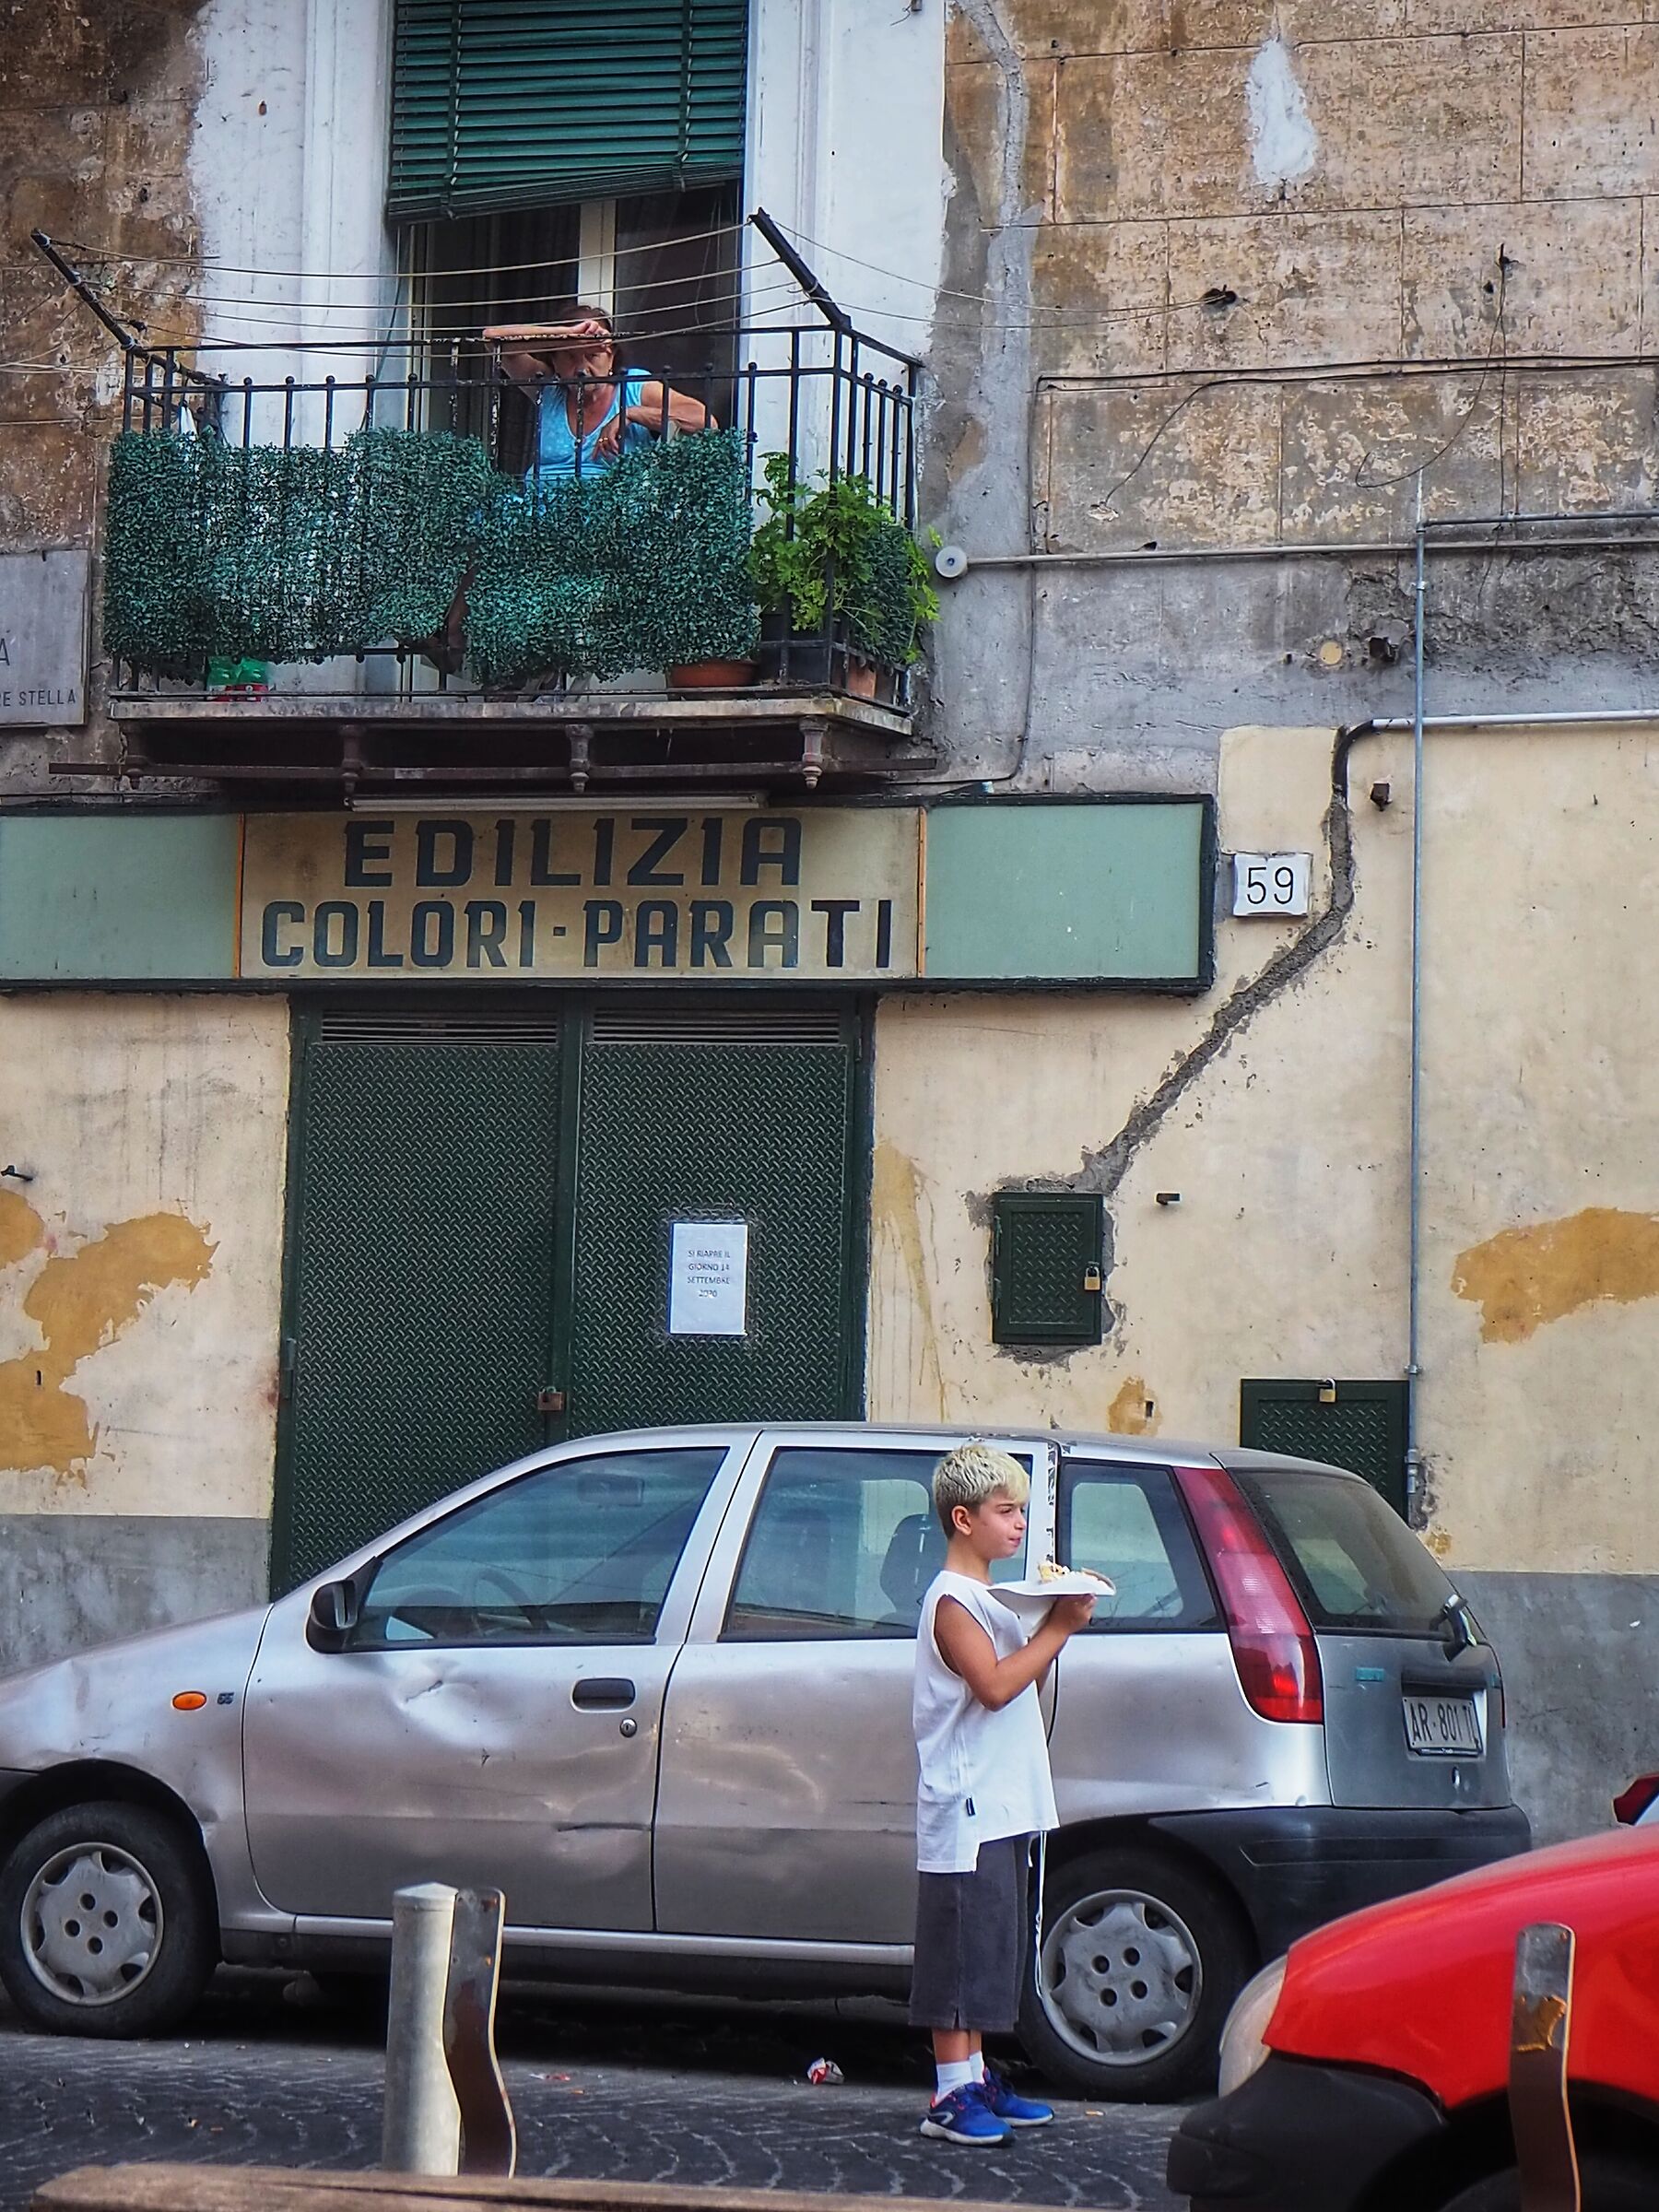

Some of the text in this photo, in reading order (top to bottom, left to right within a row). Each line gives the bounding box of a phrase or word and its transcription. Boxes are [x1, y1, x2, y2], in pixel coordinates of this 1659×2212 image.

[18, 688, 76, 707] STELLA
[344, 817, 802, 887] EDILIZIA
[1247, 866, 1294, 904] 59
[688, 1263, 719, 1271] GIORNO
[688, 1276, 731, 1285] SETTEMBRE
